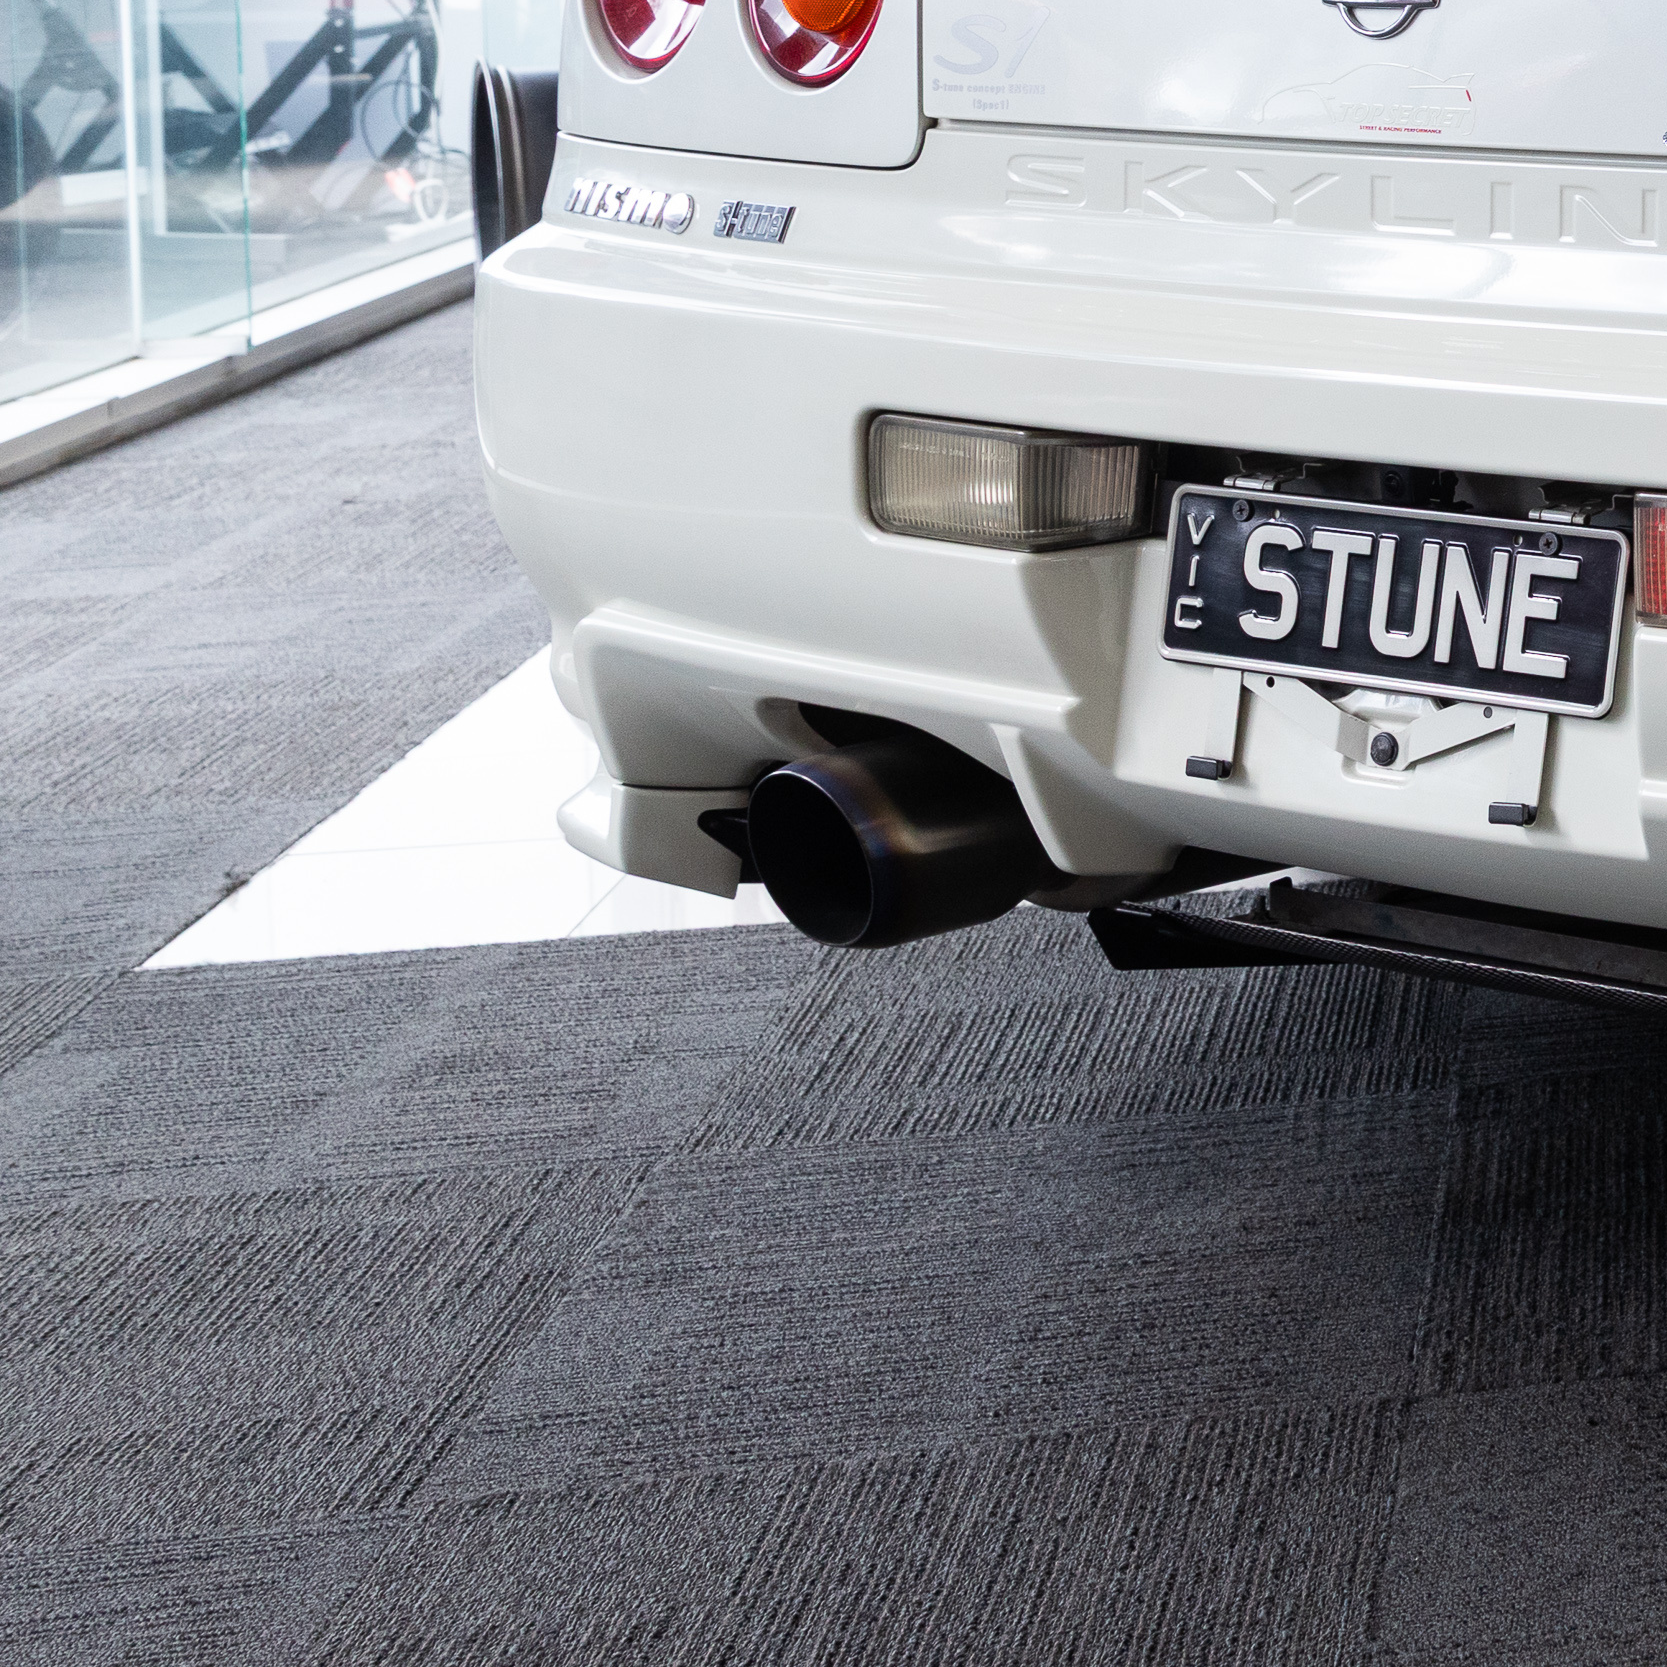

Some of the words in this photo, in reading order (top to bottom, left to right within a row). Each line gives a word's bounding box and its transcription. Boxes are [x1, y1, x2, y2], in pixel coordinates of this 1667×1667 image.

[967, 84, 1005, 94] concept
[1338, 102, 1384, 123] TOP
[1384, 104, 1471, 128] SECRET
[1237, 524, 1583, 680] STUNE
